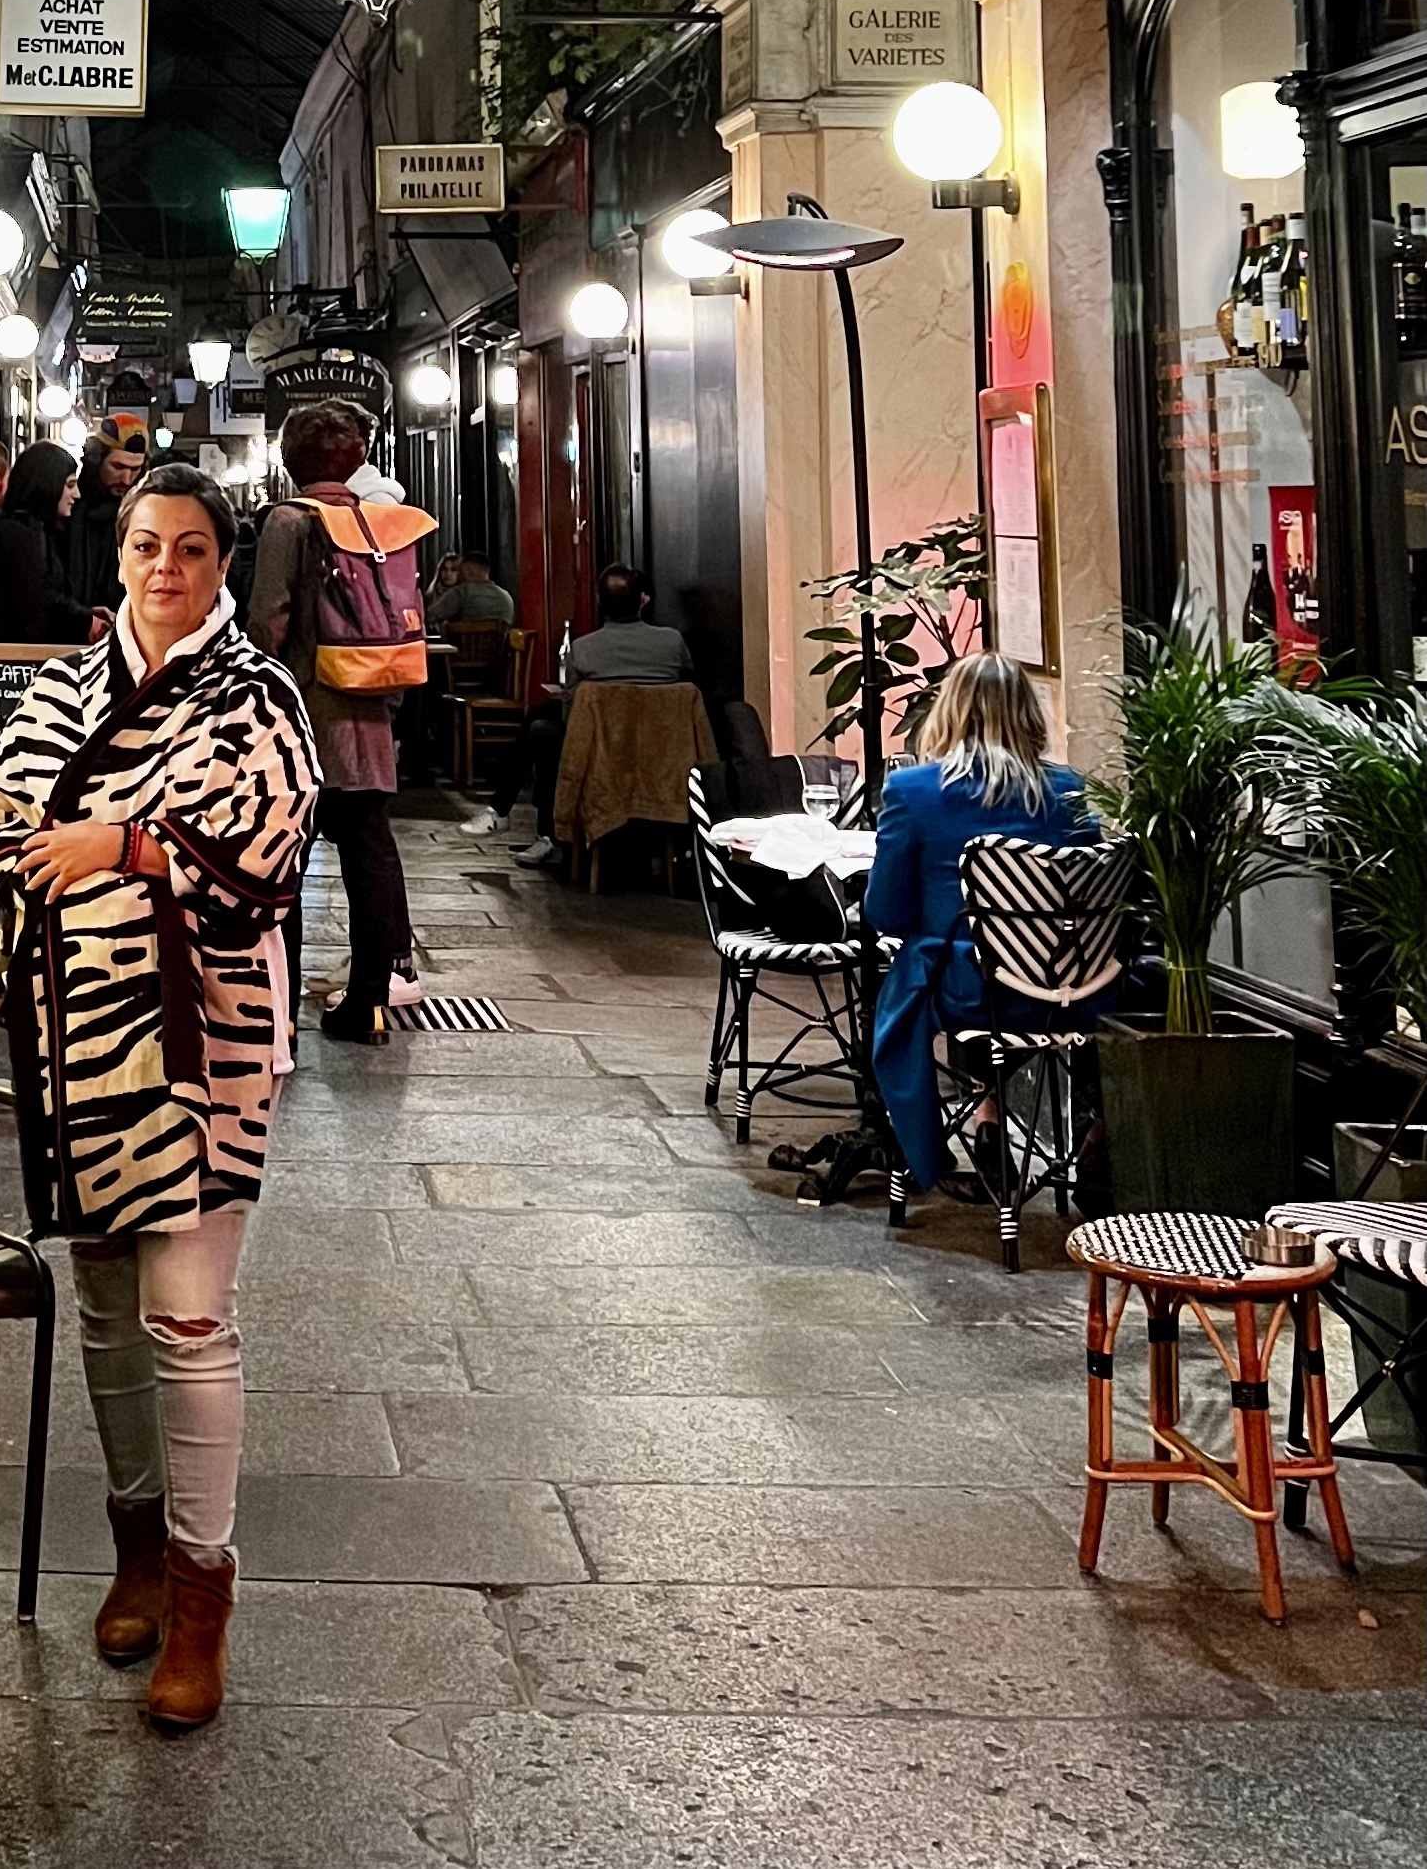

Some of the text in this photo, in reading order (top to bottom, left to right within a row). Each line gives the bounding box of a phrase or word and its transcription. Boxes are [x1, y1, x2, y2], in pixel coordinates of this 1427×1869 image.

[39, 0, 104, 15] ACHAT
[40, 19, 104, 35] VENTE
[849, 9, 941, 29] GALERIE
[17, 38, 125, 55] ESTIMATION
[884, 32, 914, 44] DES
[400, 156, 485, 173] PANORAMAS
[400, 182, 483, 199] PHILATELIE
[275, 364, 377, 390] MARÉCHAL
